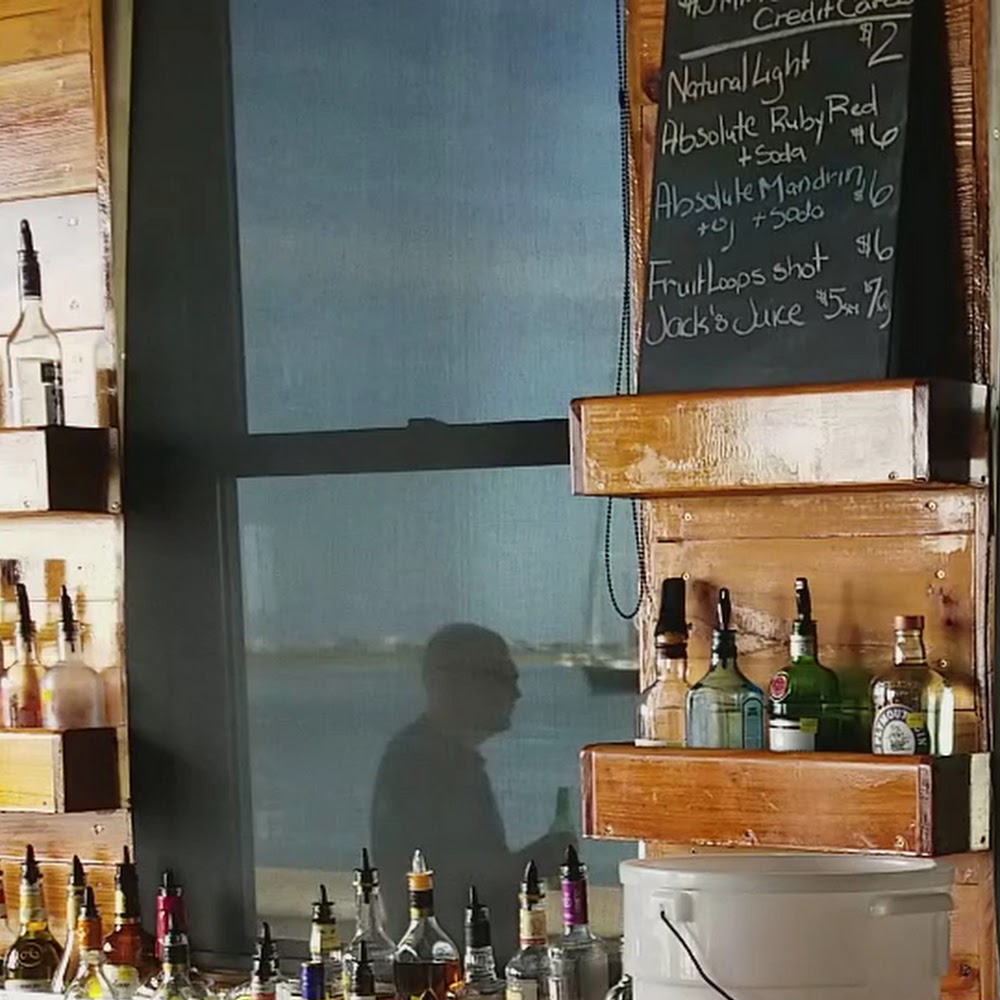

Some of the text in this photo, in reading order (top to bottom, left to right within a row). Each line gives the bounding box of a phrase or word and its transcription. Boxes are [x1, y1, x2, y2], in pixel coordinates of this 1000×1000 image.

[667, 52, 747, 111] Natural
[752, 40, 811, 105] Light
[661, 110, 759, 156] Absolute
[770, 105, 826, 145] Ruby
[824, 83, 879, 123] Red
[654, 176, 754, 220] Absolute
